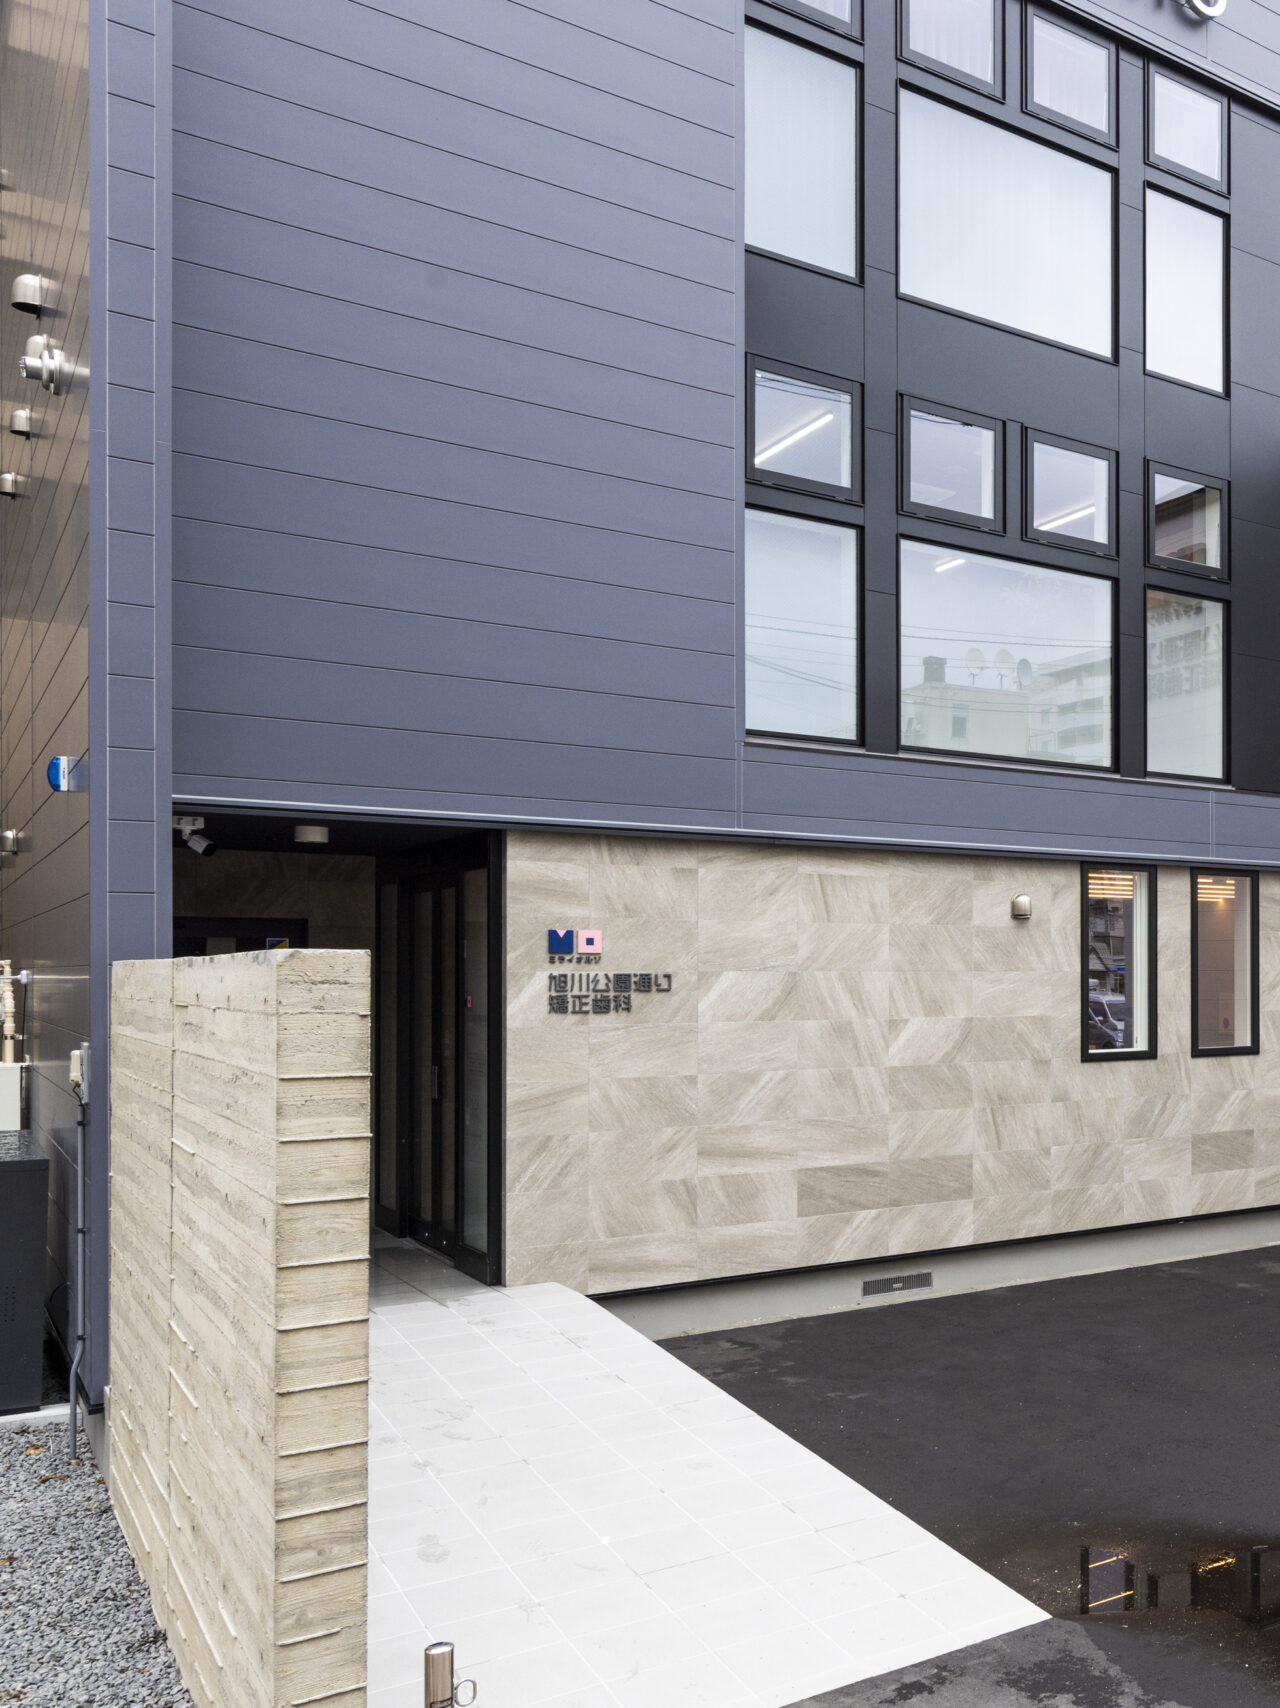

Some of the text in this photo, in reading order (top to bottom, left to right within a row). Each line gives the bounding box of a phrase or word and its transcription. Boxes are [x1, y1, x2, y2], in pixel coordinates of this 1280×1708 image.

[548, 973, 672, 993] 旭川公園通り
[548, 994, 632, 1015] 矯正歯科
